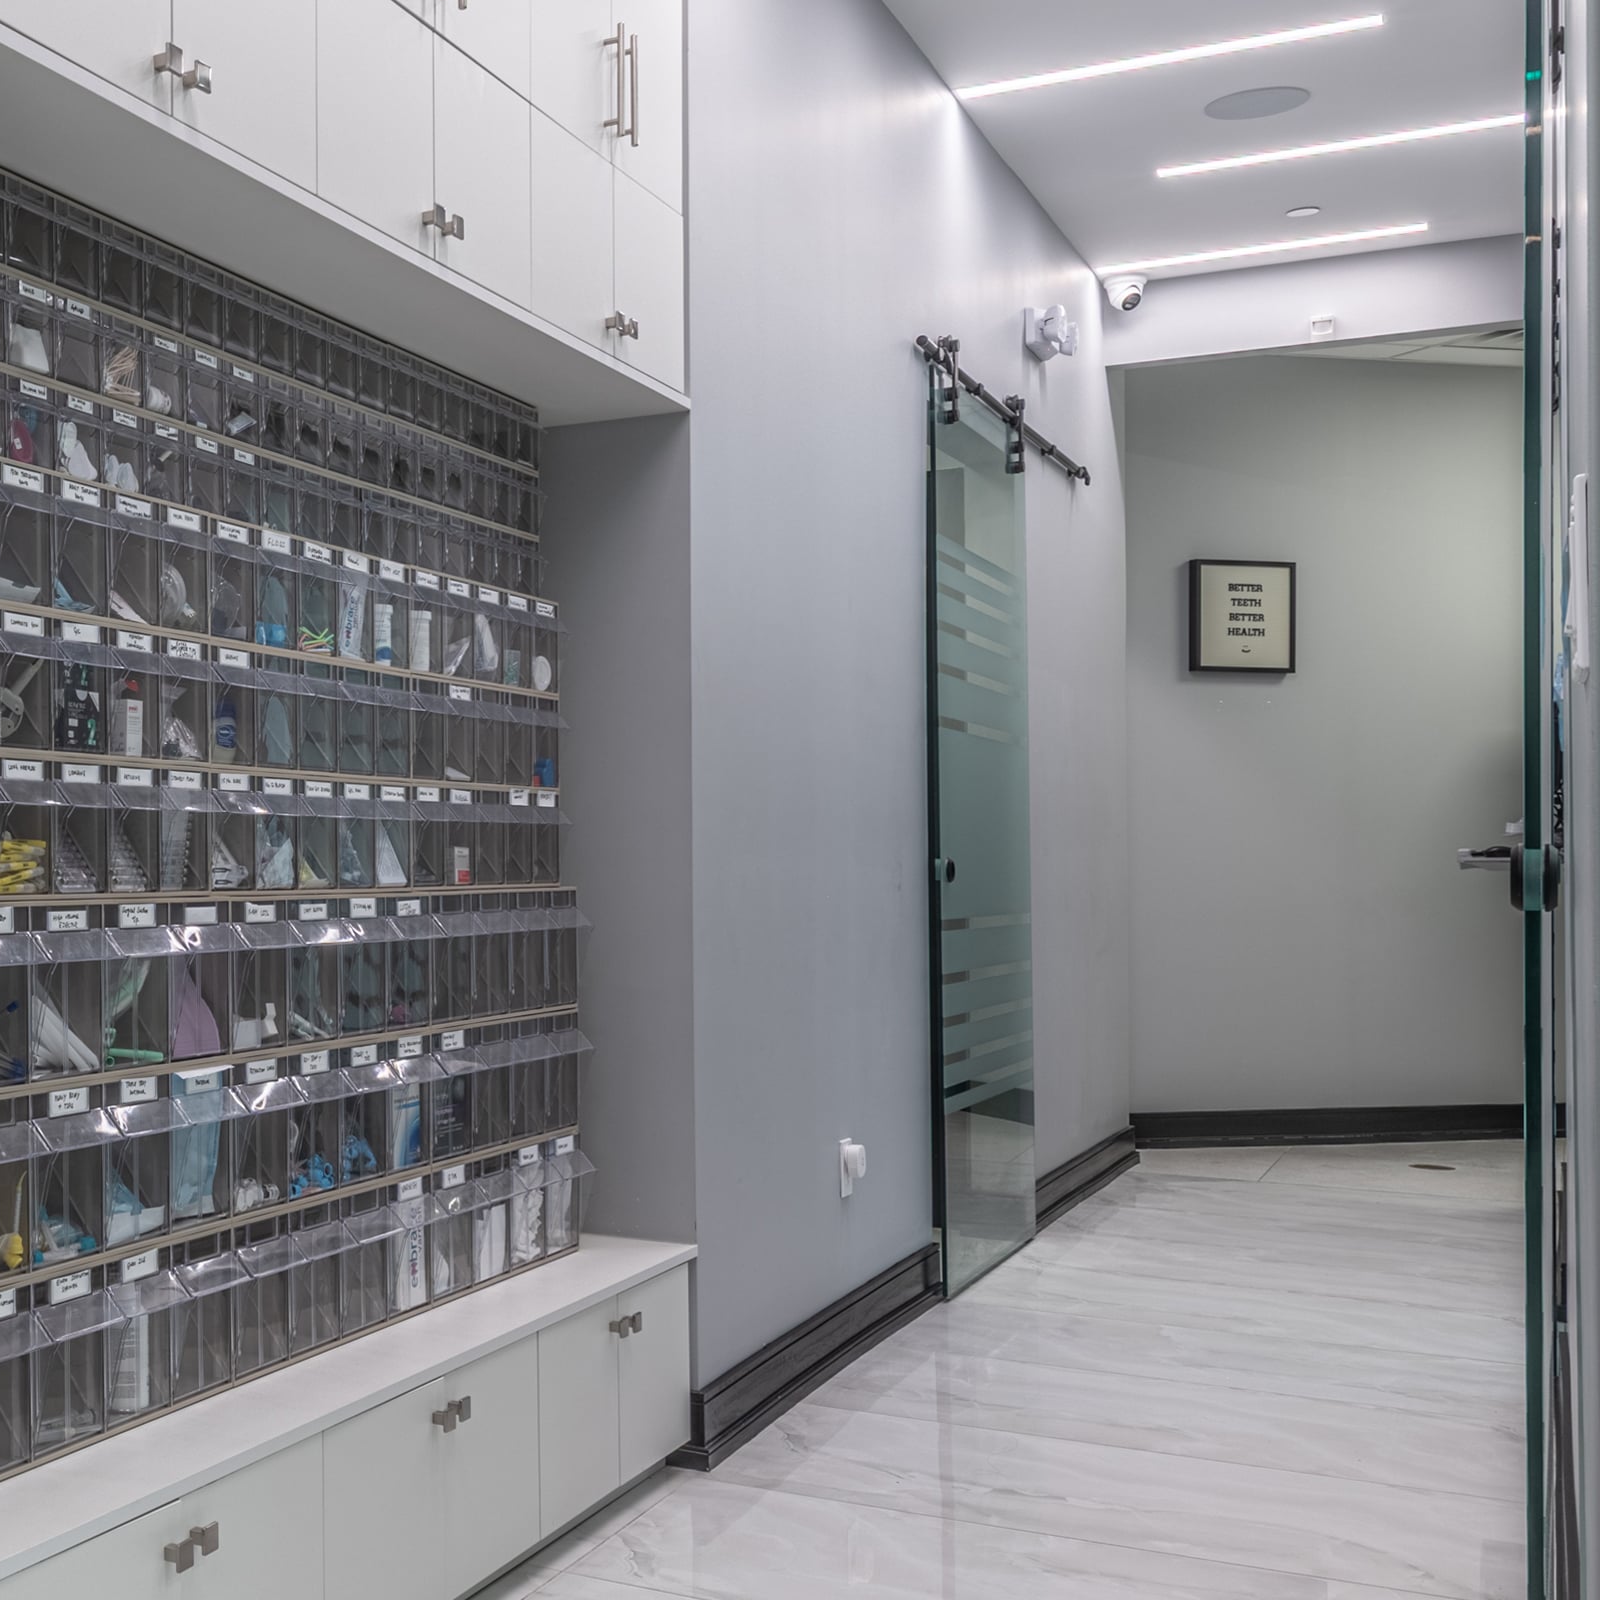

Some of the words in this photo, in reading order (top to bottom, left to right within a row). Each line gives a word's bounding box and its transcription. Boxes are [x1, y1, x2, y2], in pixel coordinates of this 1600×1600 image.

[1228, 583, 1263, 593] BETTER
[1230, 598, 1262, 608] TEETH
[1228, 612, 1265, 622] BETTER
[1227, 627, 1266, 637] HEALTH
